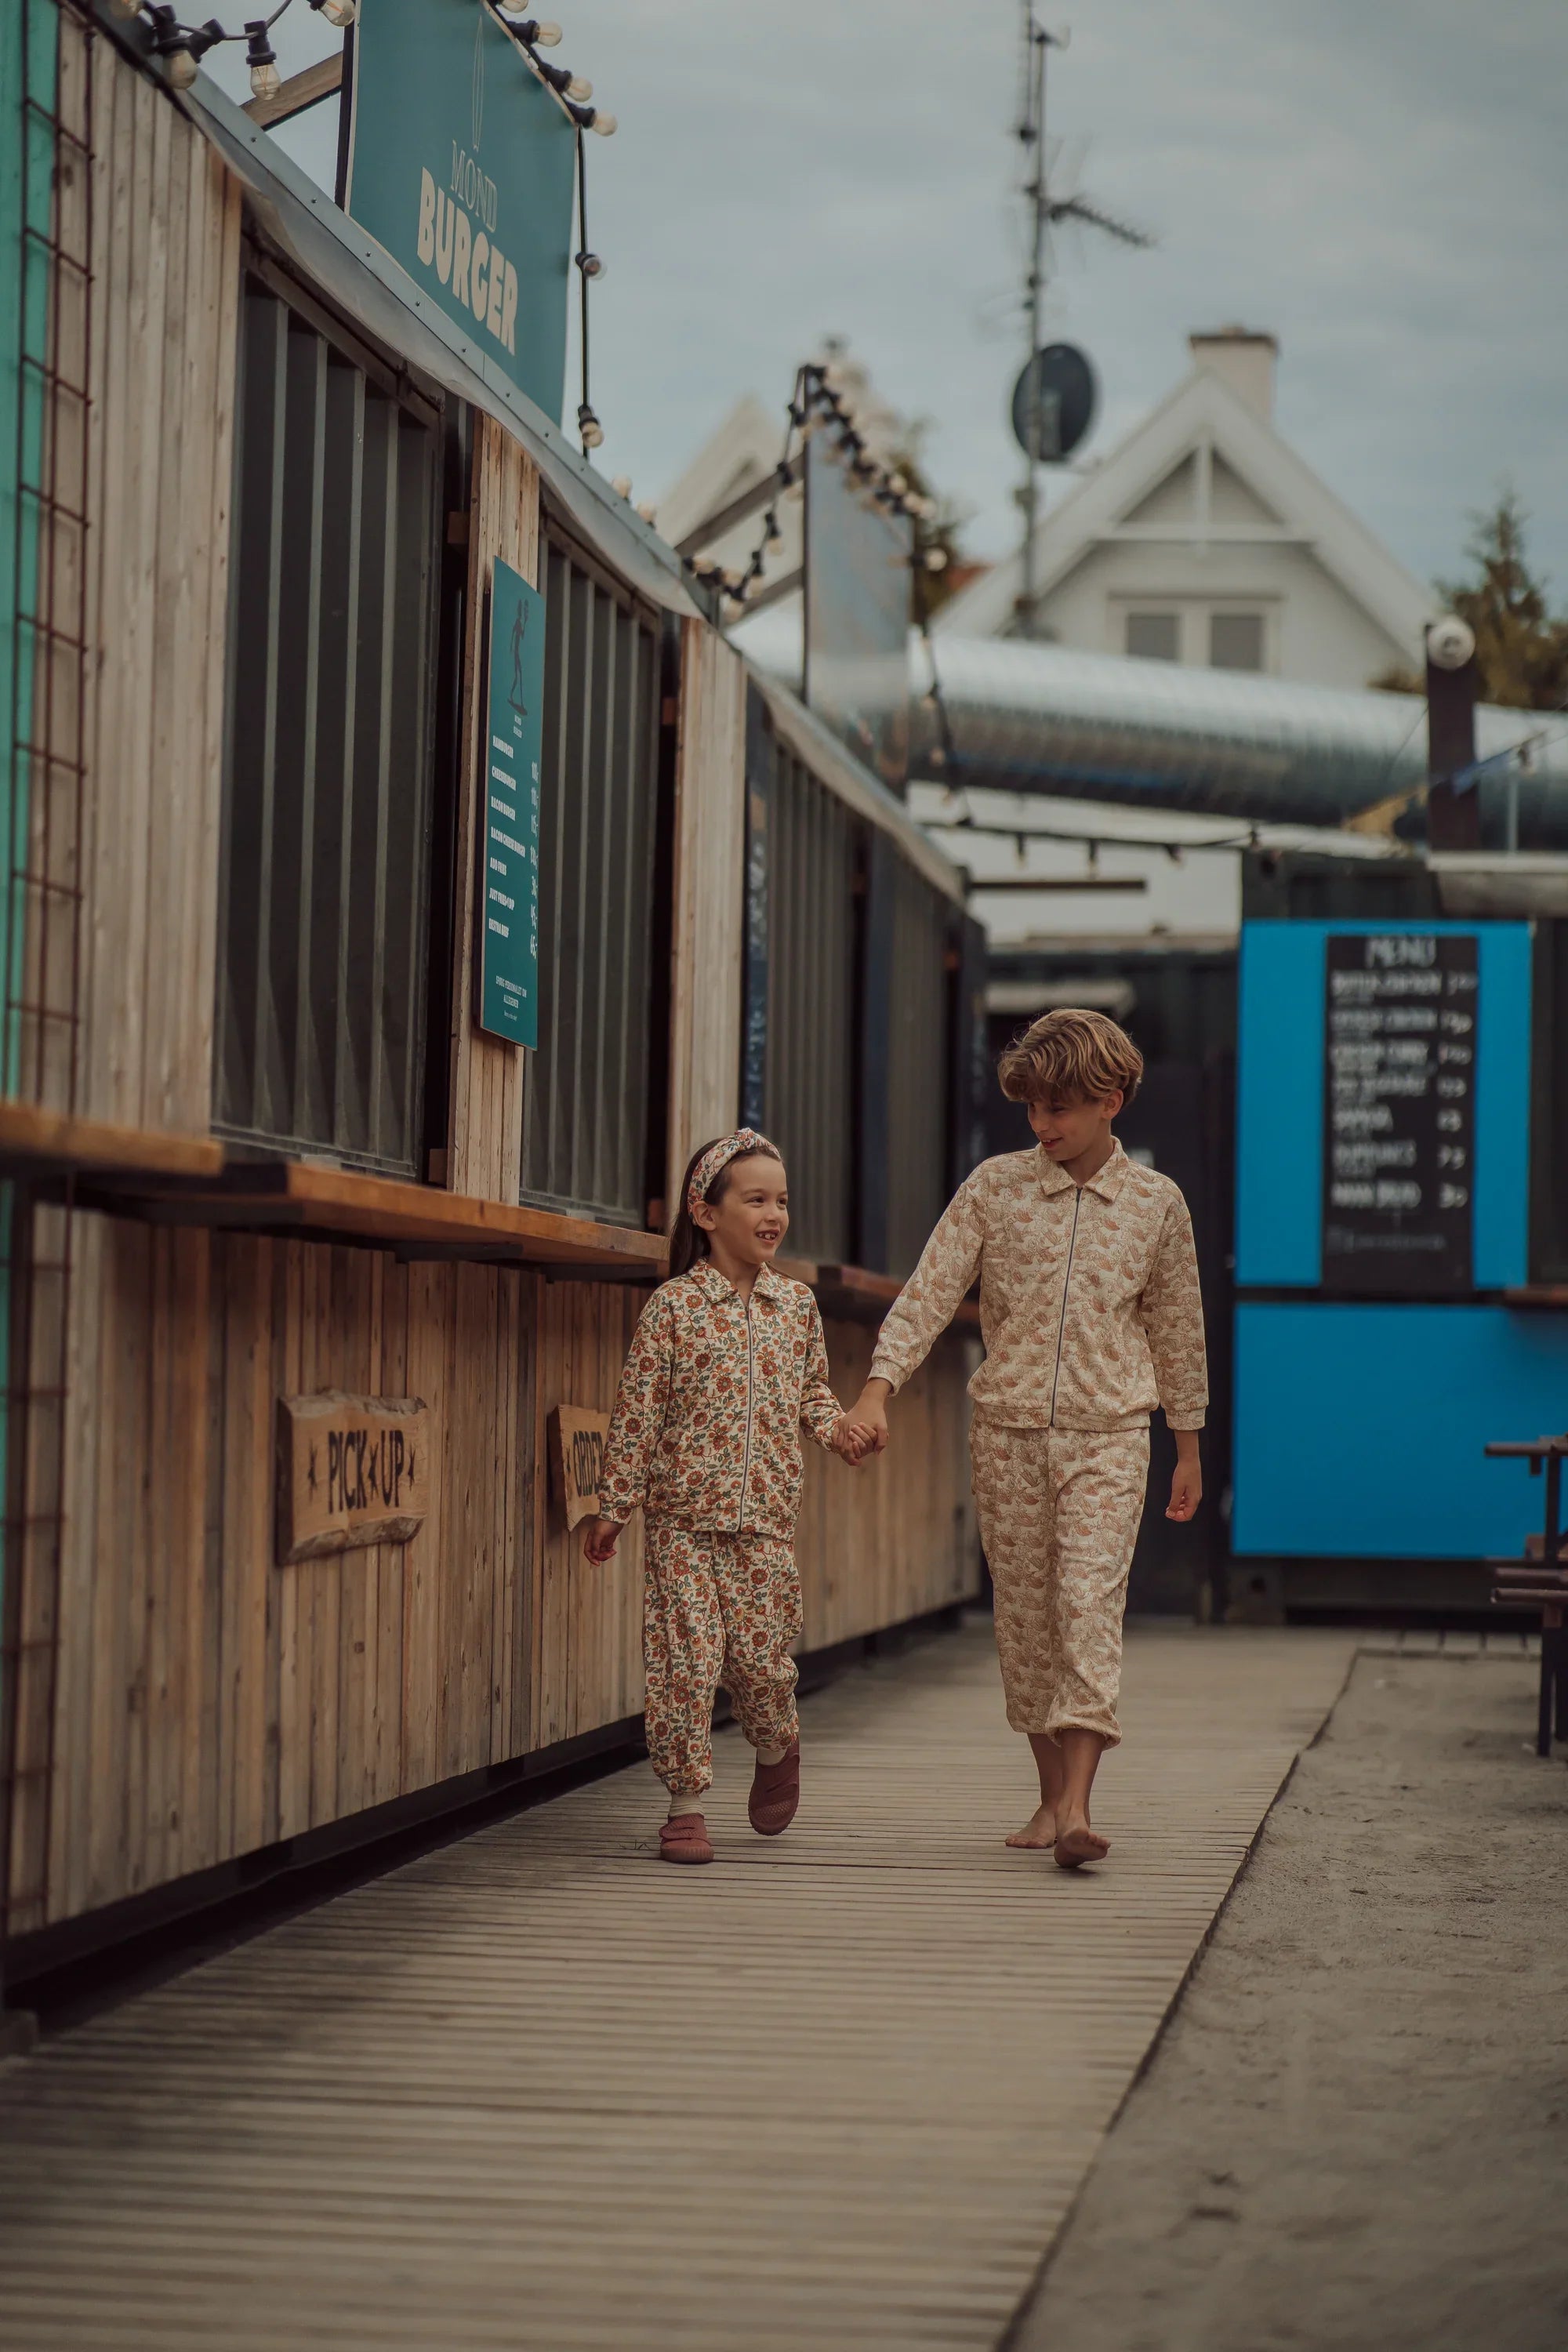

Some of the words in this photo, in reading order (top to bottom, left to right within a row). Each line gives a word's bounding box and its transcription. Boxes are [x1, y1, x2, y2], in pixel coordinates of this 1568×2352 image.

[451, 139, 499, 233] MOND
[417, 166, 518, 357] BURGER
[328, 1429, 368, 1515] PICK
[380, 1429, 405, 1508] UP
